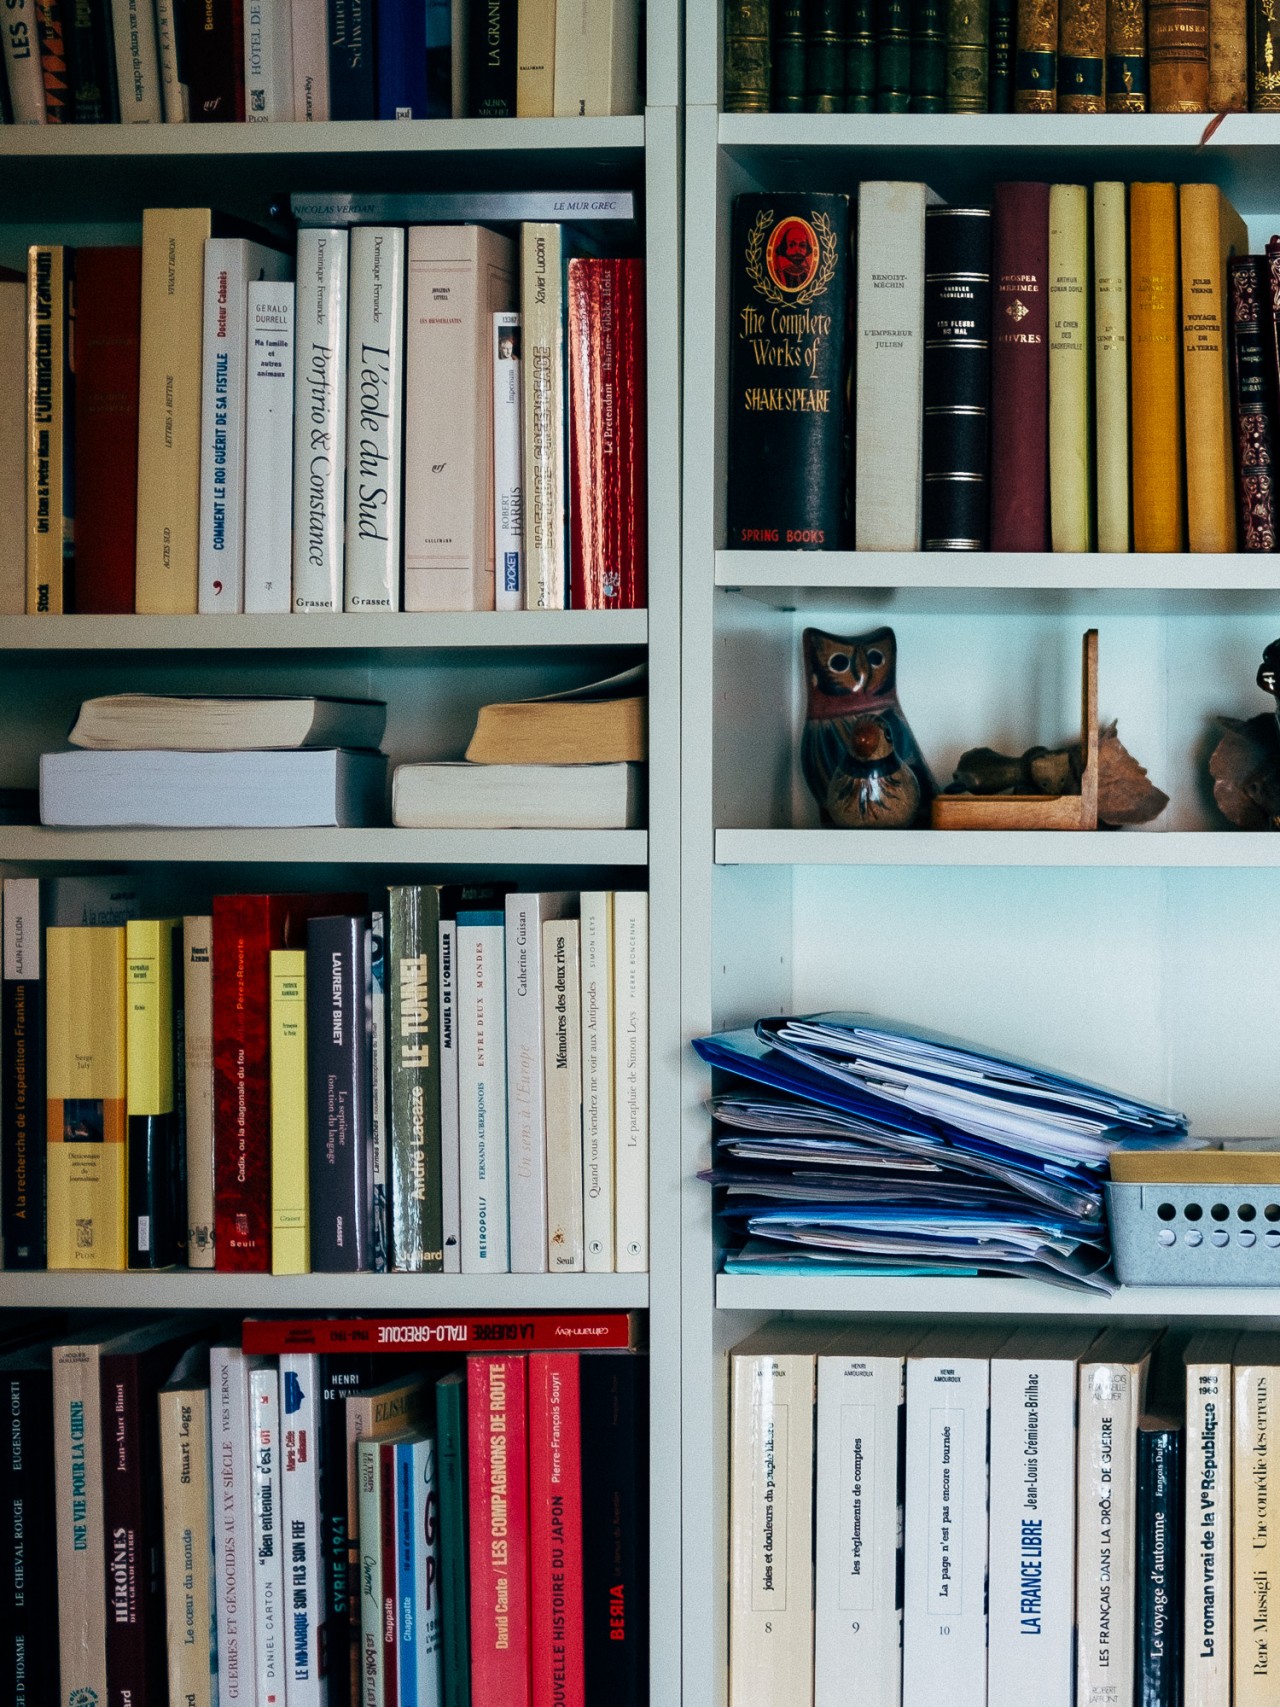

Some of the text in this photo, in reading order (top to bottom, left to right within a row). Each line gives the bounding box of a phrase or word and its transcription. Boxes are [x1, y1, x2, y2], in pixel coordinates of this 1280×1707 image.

[10, 21, 31, 59] LES
[249, 6, 261, 75] HÔTEL DE
[554, 201, 616, 211] LE MUR GREC
[256, 304, 287, 313] GERALD
[256, 315, 287, 324] DURRELL
[740, 304, 831, 340] The Complete
[752, 339, 821, 379] Works of
[744, 388, 830, 413] SHAKESPEARE
[211, 352, 228, 550] COMMENT LE ROI GUÉRIT DE SA FISTULE
[307, 343, 332, 567] Porfirio & Constance
[358, 343, 389, 541] L'école du Sud
[511, 486, 521, 537] HARRIS
[741, 529, 825, 543] SPRING BOOKS
[506, 552, 518, 592] POCKET
[352, 597, 390, 606] Grasset
[16, 917, 24, 975] ALAIN FILLION
[517, 911, 527, 997] Catherine Guisan
[332, 952, 342, 1045] LAURENT BINET
[443, 933, 452, 1048] MANUEL DE L'OREILLER
[555, 937, 568, 1069] Mémoires des deux rives
[13, 985, 25, 1036] Franklin
[13, 1039, 27, 1110] l'expédition
[627, 1011, 639, 1147] Le parapluie de Simon Leys
[14, 1113, 25, 1128] de
[15, 1132, 26, 1192] recherche
[15, 1195, 25, 1207] la
[490, 1364, 506, 1410] ROUTE
[12, 1381, 21, 1471] EUGENIO CORTI
[490, 1413, 506, 1433] DE
[943, 1426, 951, 1464] tournée
[1201, 1402, 1219, 1490] République
[491, 1437, 506, 1534] COMPAGNONS
[1021, 1373, 1042, 1634] LA FRANCE LIBRE Jean-Louis Crémieux-Brilhac
[852, 1438, 863, 1575] les règlements de comptes
[943, 1505, 951, 1523] pas
[1201, 1512, 1215, 1526] la
[491, 1537, 507, 1566] LES
[1201, 1530, 1215, 1549] de
[941, 1555, 951, 1580] page
[1151, 1511, 1168, 1657] Le voyage d'automne
[1201, 1551, 1215, 1584] vrai
[495, 1578, 507, 1611] Caute
[940, 1584, 948, 1597] La
[852, 1622, 860, 1633] 9
[1204, 1586, 1215, 1635] roman
[496, 1613, 508, 1649] David
[940, 1626, 950, 1635] 10
[1201, 1638, 1214, 1658] Le
